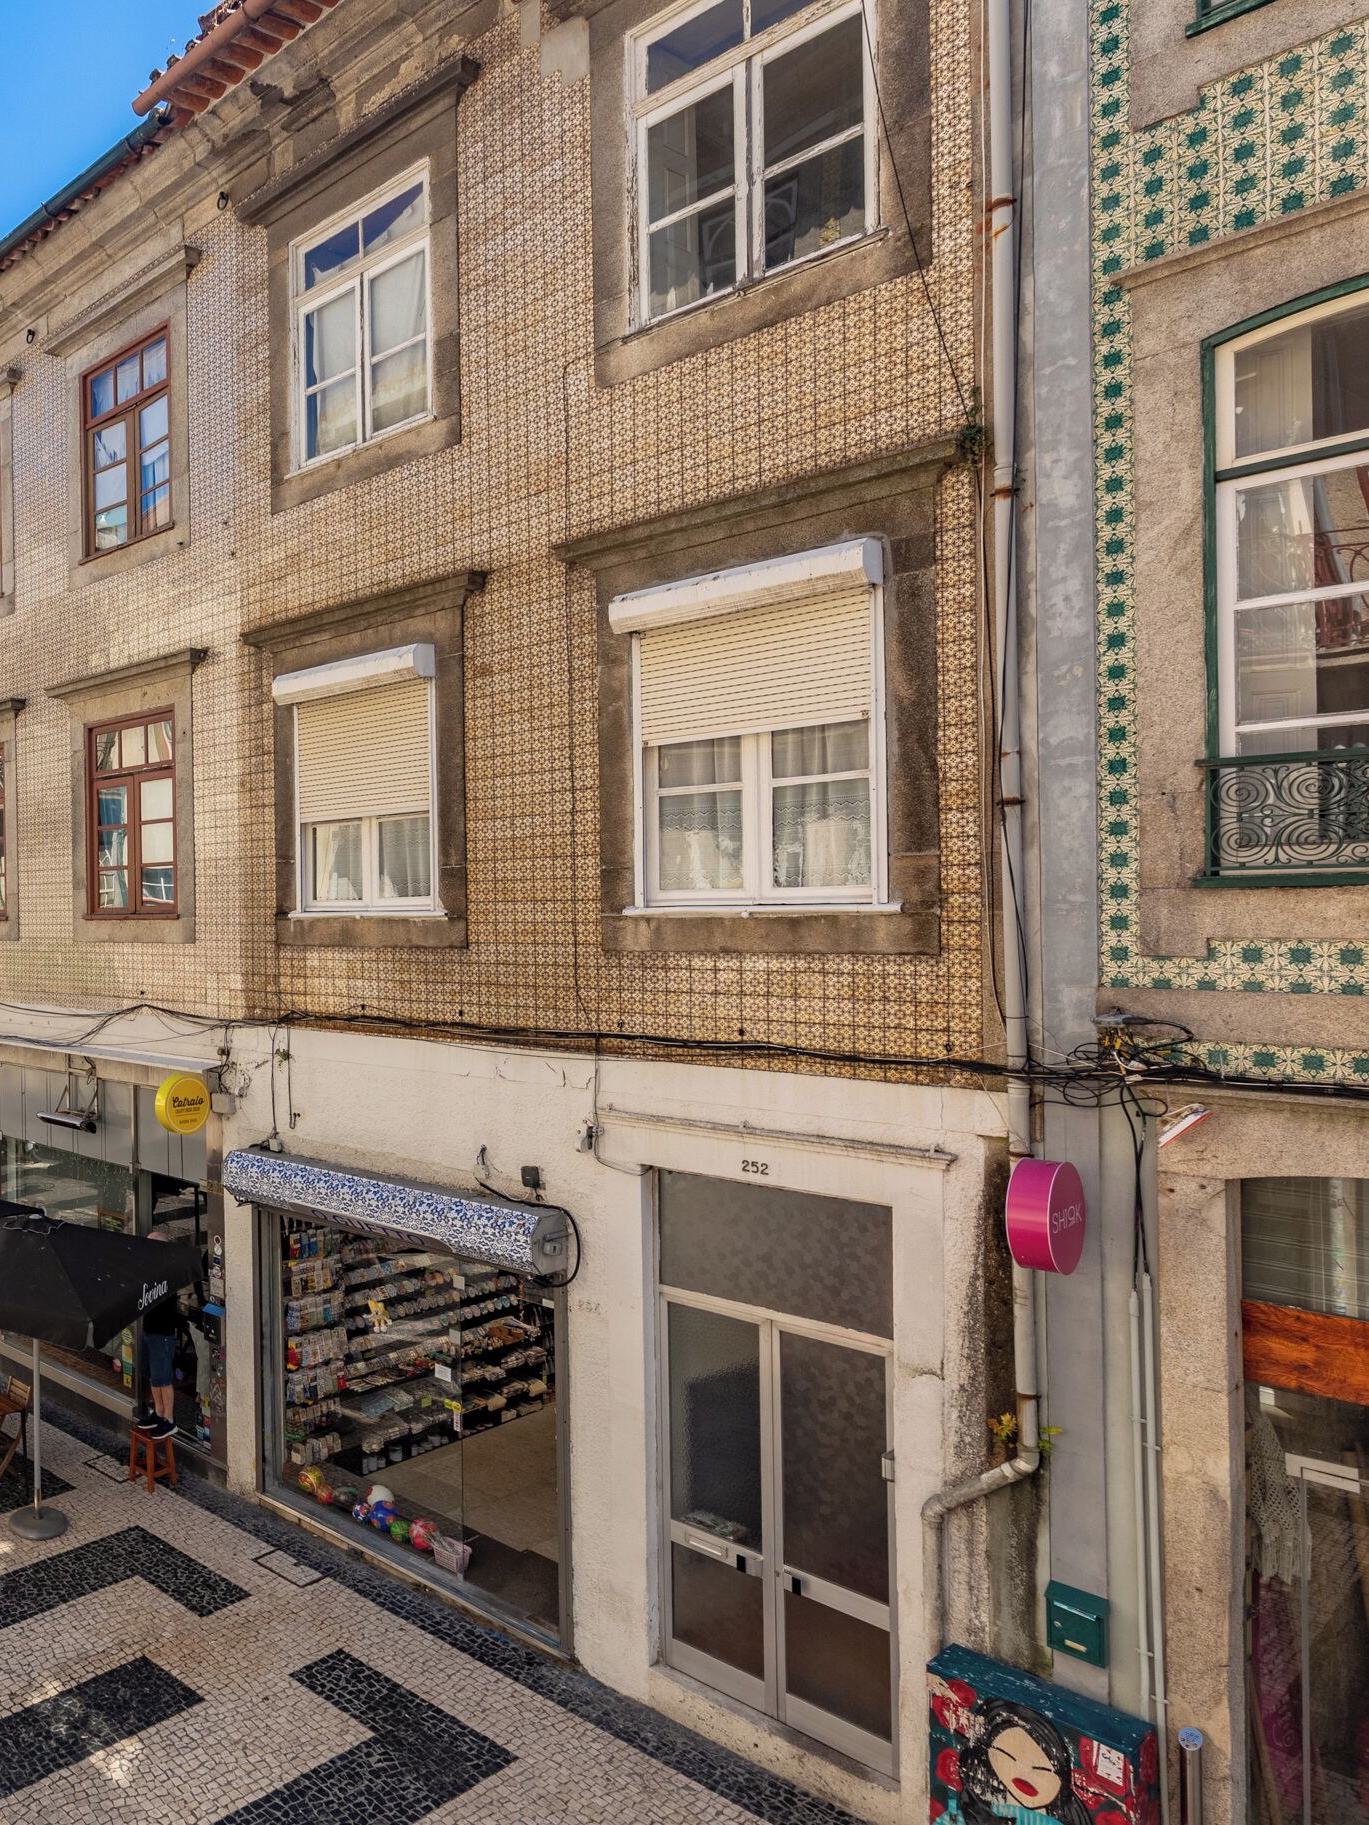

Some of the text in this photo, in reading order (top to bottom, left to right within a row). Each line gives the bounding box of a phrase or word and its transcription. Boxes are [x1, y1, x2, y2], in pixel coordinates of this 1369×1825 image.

[172, 1096, 204, 1108] Catraio
[742, 1160, 769, 1175] 252
[138, 1280, 168, 1310] Sovina
